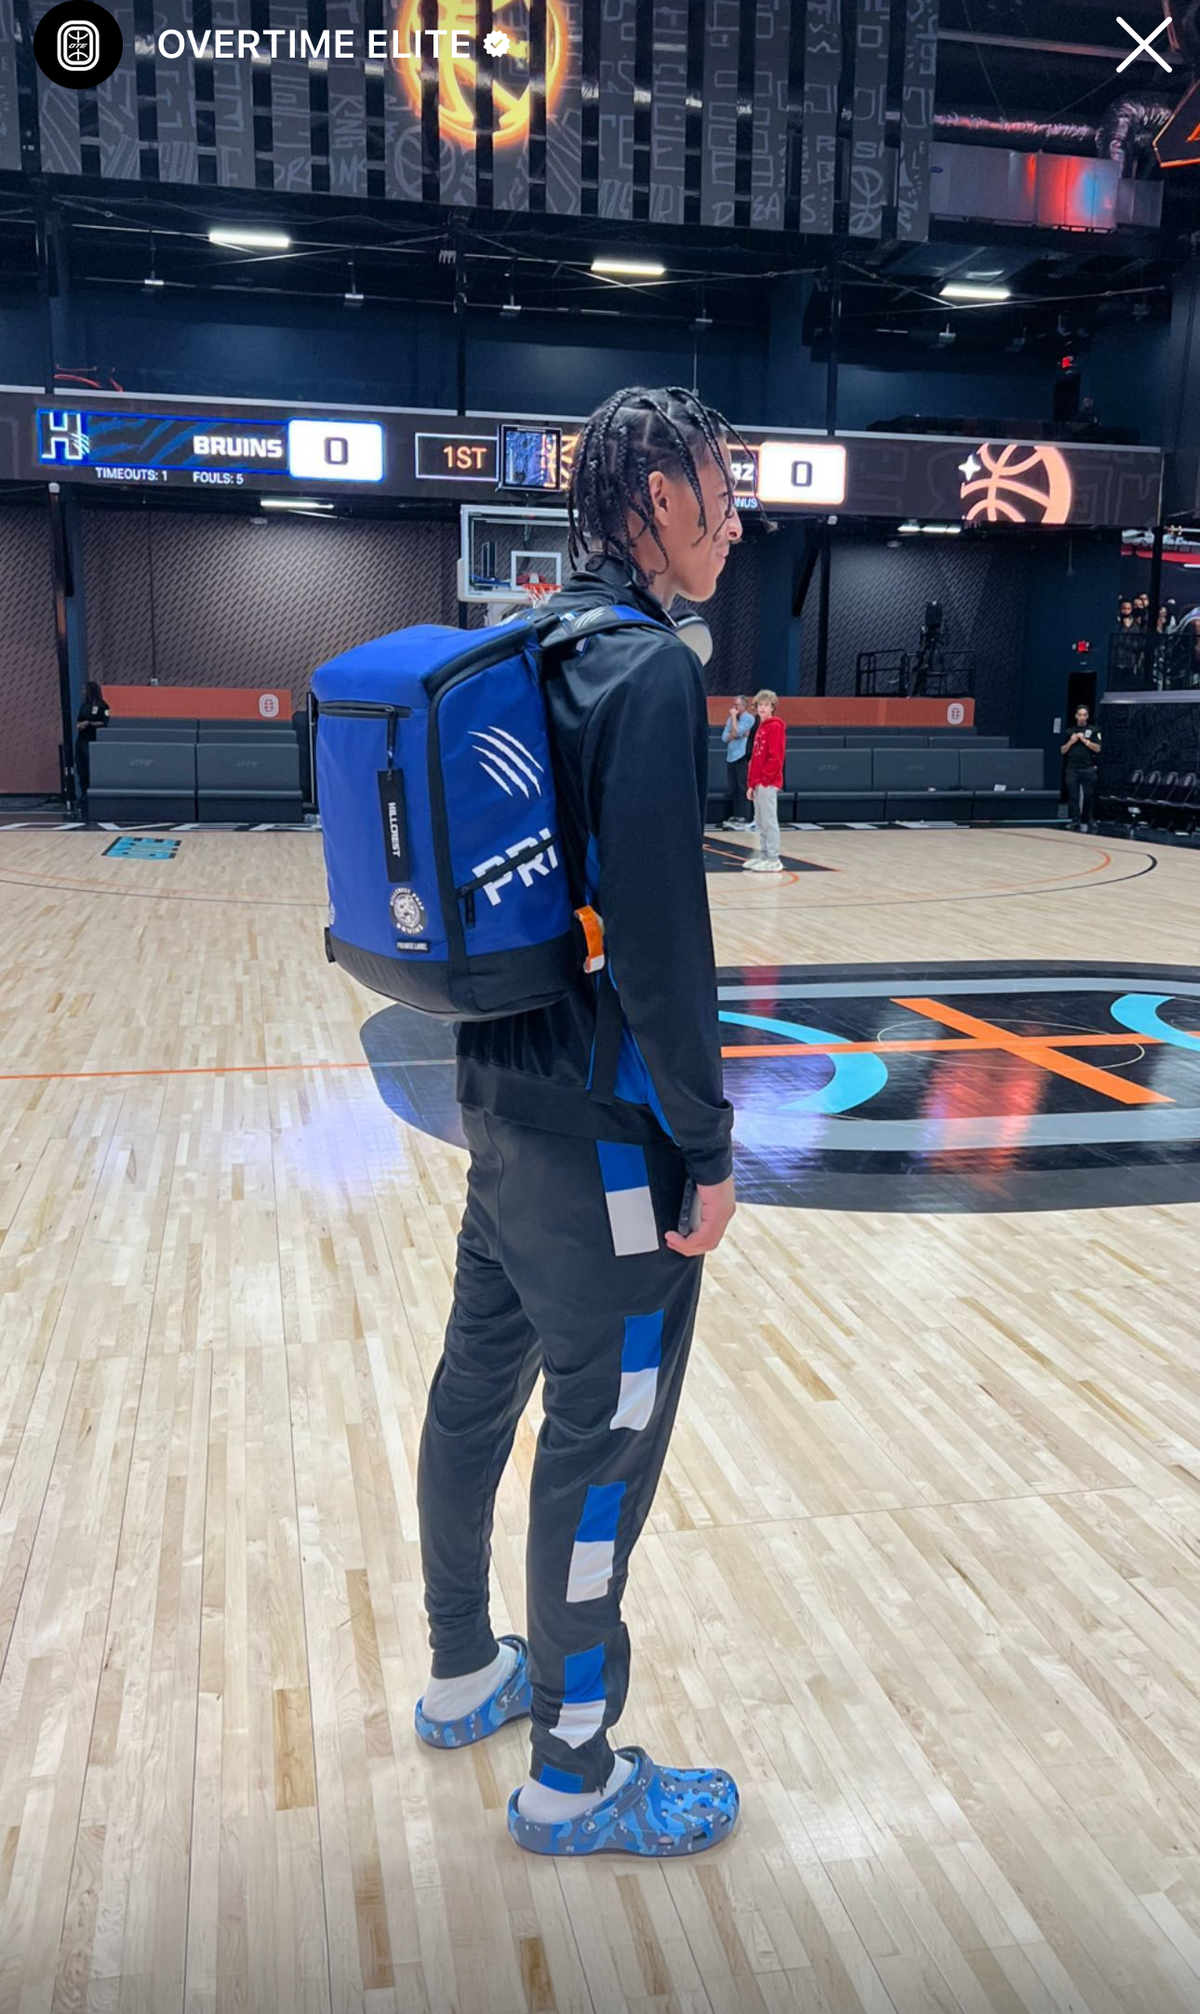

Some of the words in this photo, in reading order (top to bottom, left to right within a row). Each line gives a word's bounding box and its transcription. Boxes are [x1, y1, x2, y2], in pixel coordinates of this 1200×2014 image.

[192, 436, 284, 459] BRUINS
[323, 437, 349, 466] 0
[443, 445, 488, 470] 1ST
[95, 466, 160, 482] TIMEOUTS:
[161, 470, 169, 482] 1
[192, 472, 235, 485] FOULS:
[235, 474, 245, 486] 5
[790, 460, 813, 487] 0
[387, 802, 401, 857] HILLCREST
